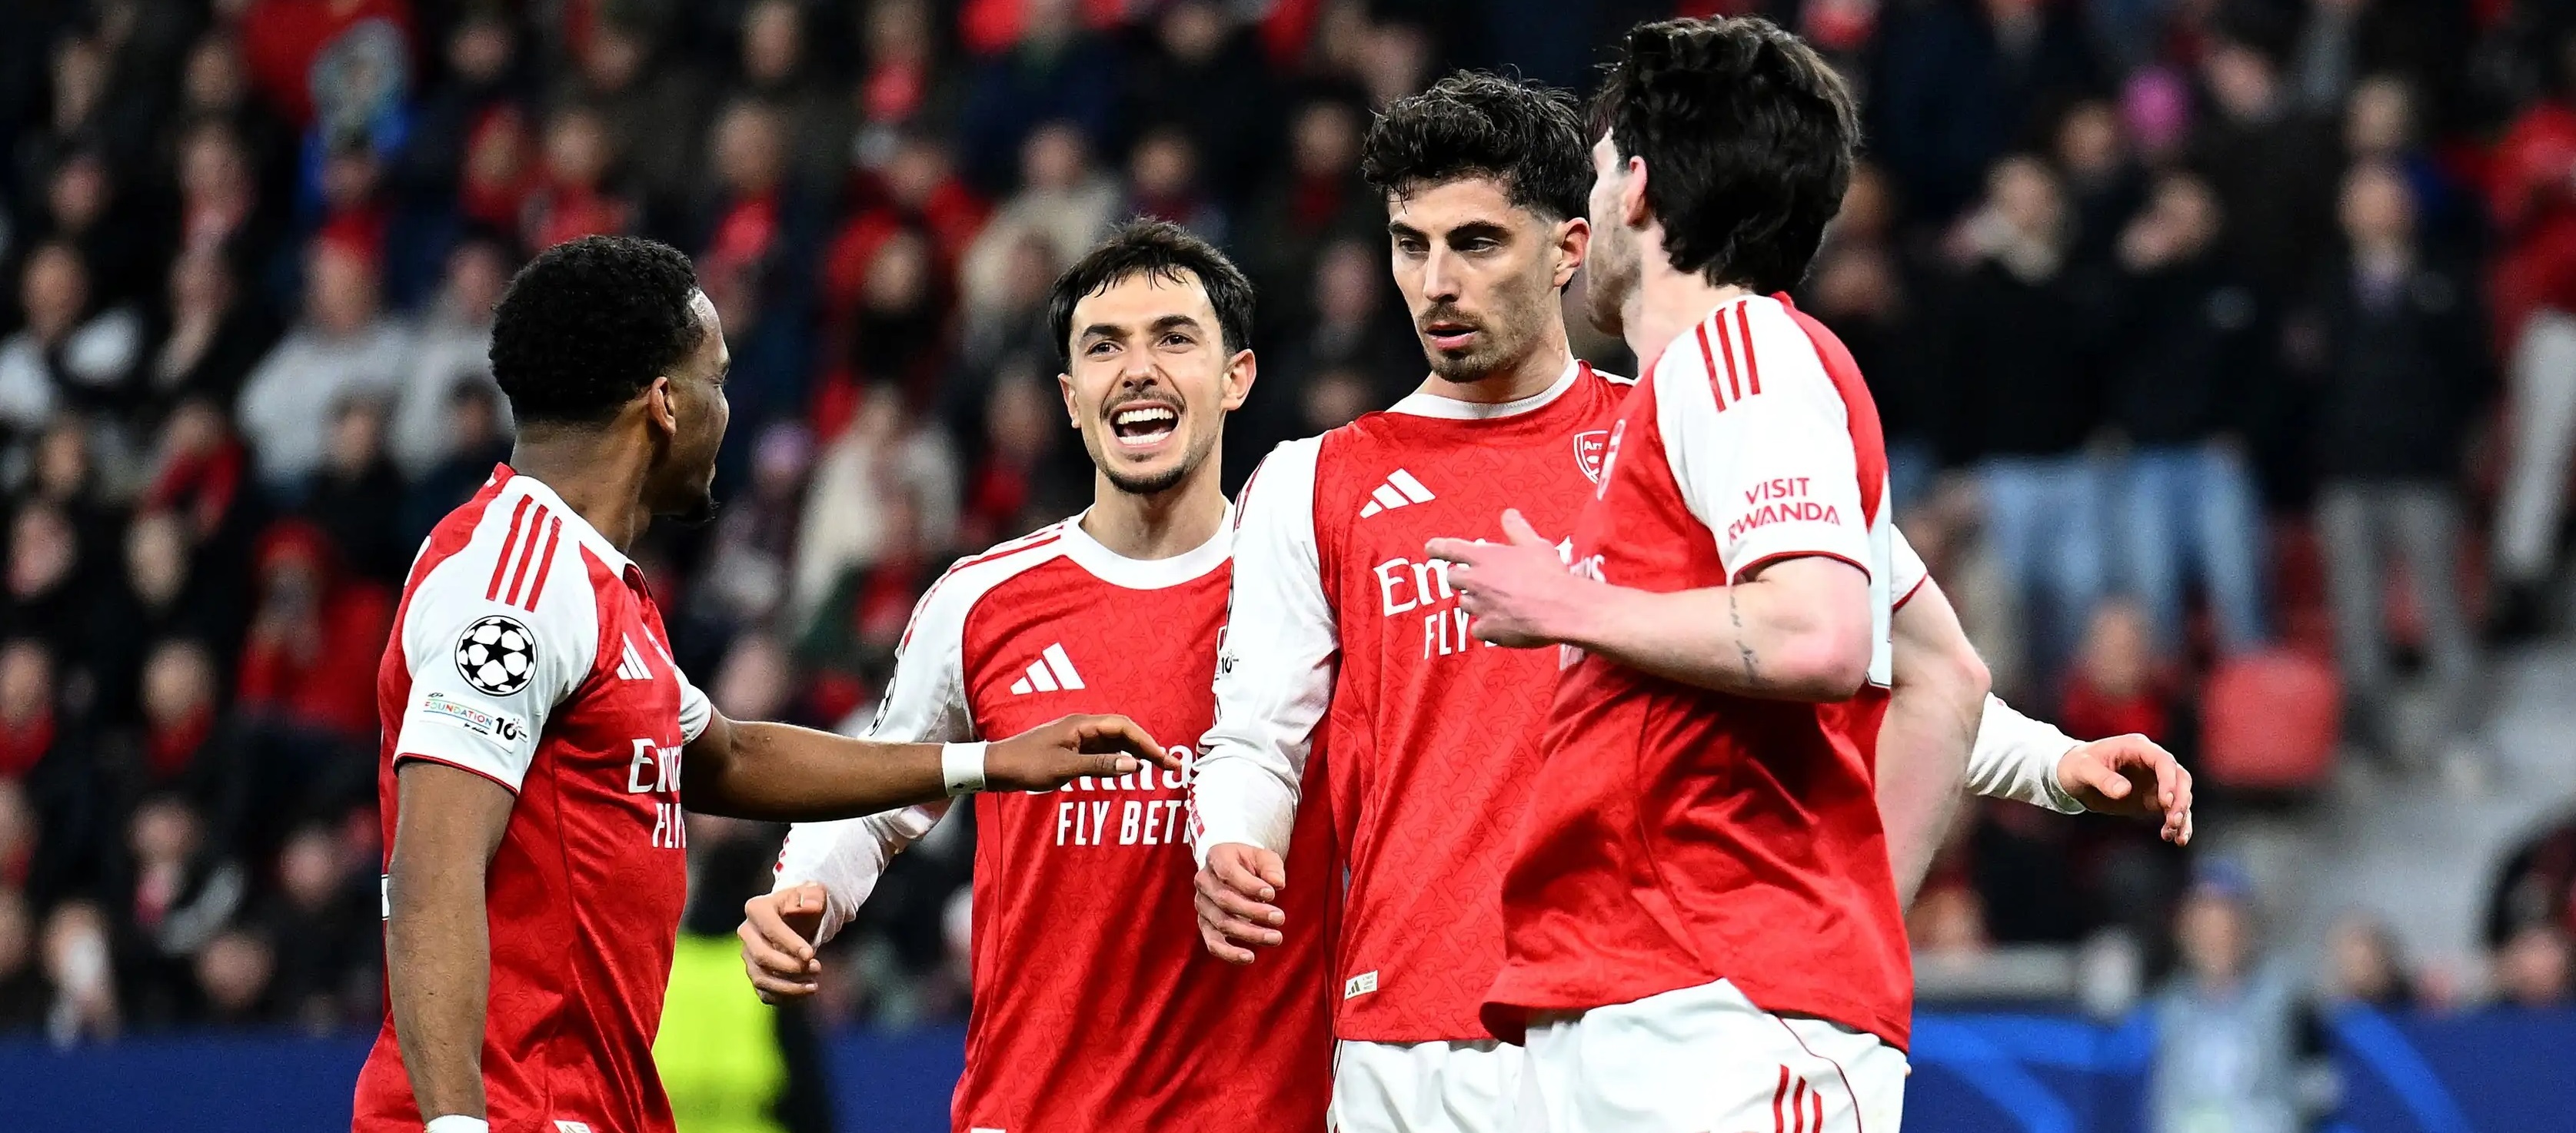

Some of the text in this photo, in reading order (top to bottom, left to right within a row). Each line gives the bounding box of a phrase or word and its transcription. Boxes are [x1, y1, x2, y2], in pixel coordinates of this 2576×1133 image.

[1746, 477, 1810, 505] VISIT
[1424, 606, 1470, 660] FLY
[424, 700, 494, 728] FOUNDATION
[1056, 800, 1112, 846] FLY
